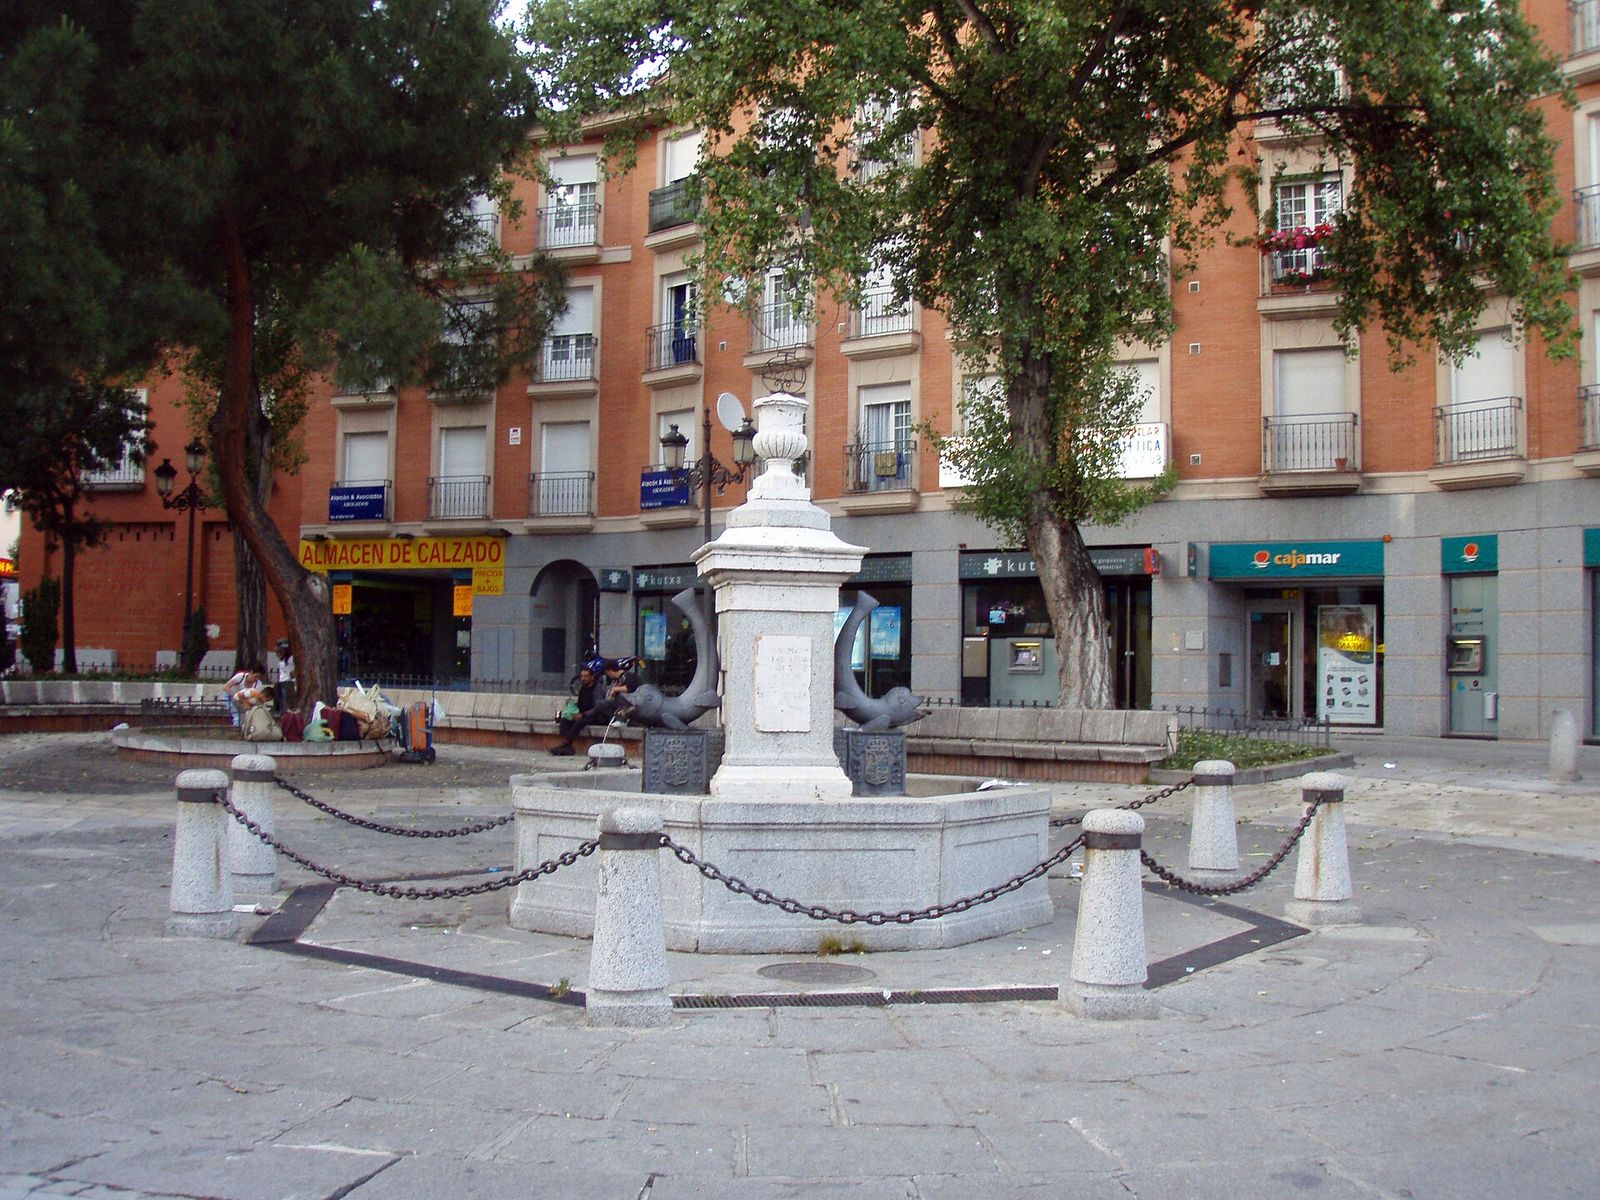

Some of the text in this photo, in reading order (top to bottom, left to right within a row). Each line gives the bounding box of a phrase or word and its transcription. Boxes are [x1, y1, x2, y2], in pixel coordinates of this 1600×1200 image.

[302, 541, 502, 565] ALMACEN DE CALZADO
[1274, 550, 1342, 569] cajamar
[1007, 560, 1036, 572] kut
[650, 574, 682, 585] kutxa
